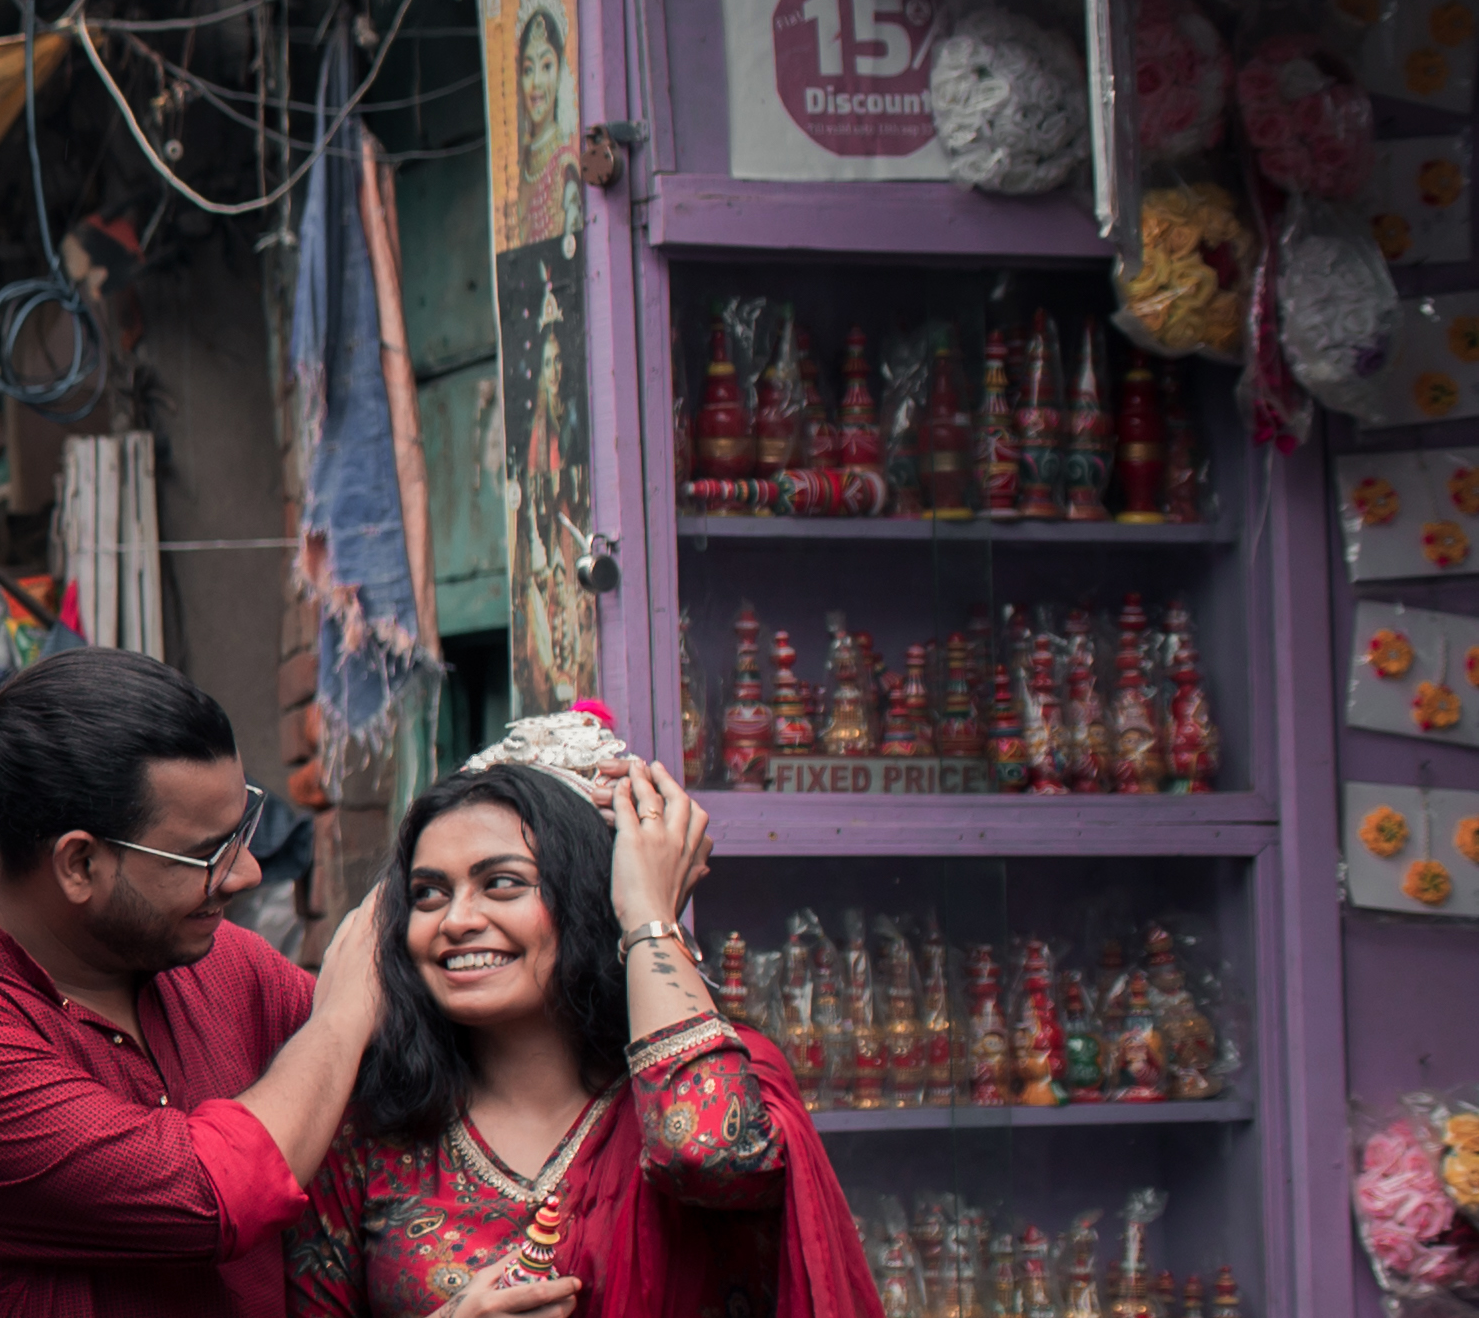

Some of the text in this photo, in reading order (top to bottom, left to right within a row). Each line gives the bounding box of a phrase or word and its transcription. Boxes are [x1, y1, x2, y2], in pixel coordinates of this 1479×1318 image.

[805, 86, 932, 115] Discount
[775, 764, 982, 793] FIXED PRICE
